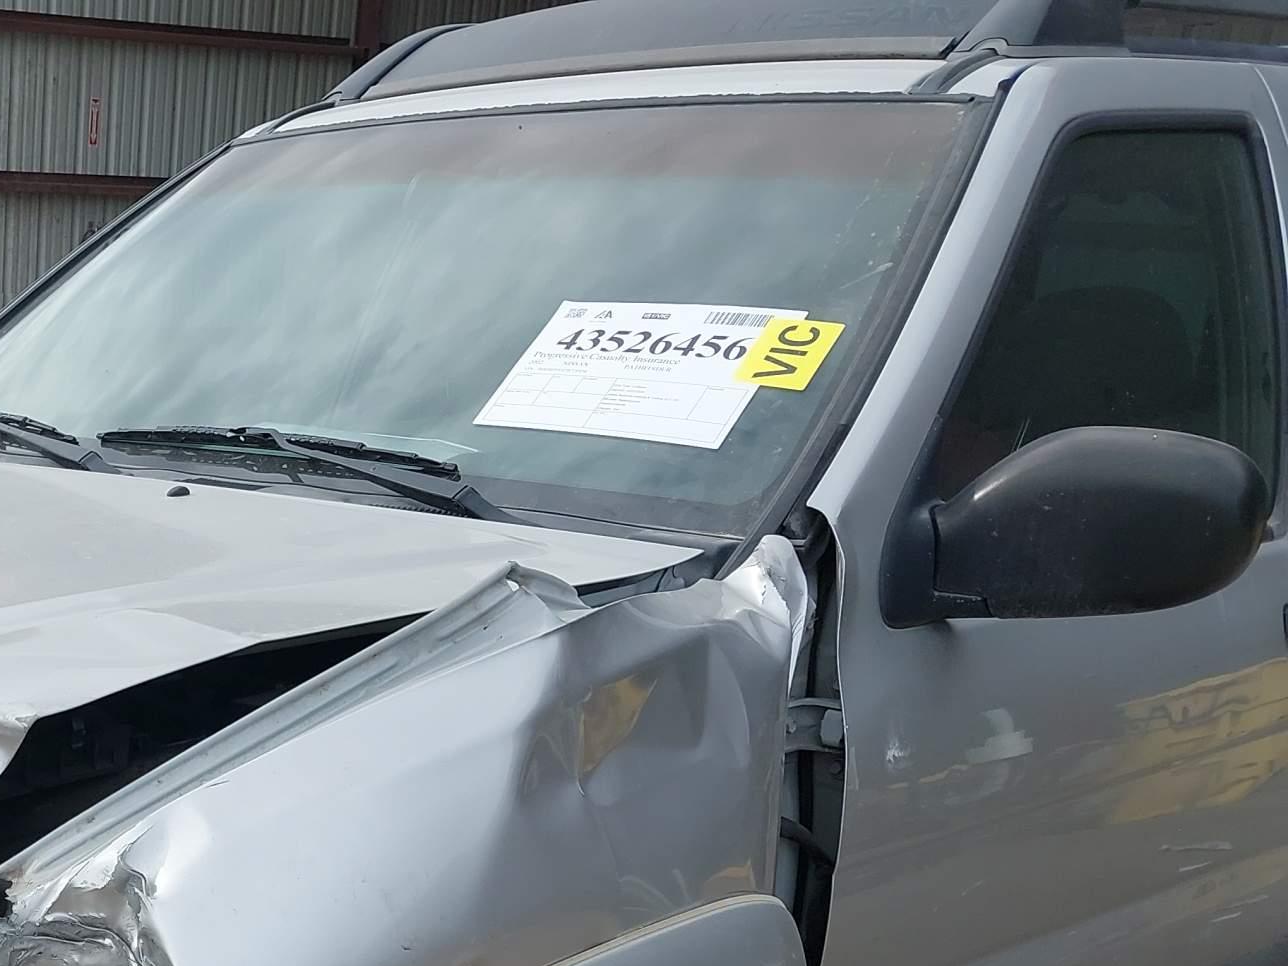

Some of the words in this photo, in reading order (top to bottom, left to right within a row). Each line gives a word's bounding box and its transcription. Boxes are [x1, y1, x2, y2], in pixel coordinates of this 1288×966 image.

[556, 328, 755, 361] 43526456
[589, 353, 629, 363] Casualty
[633, 356, 681, 365] Insurance
[752, 325, 821, 378] VIC
